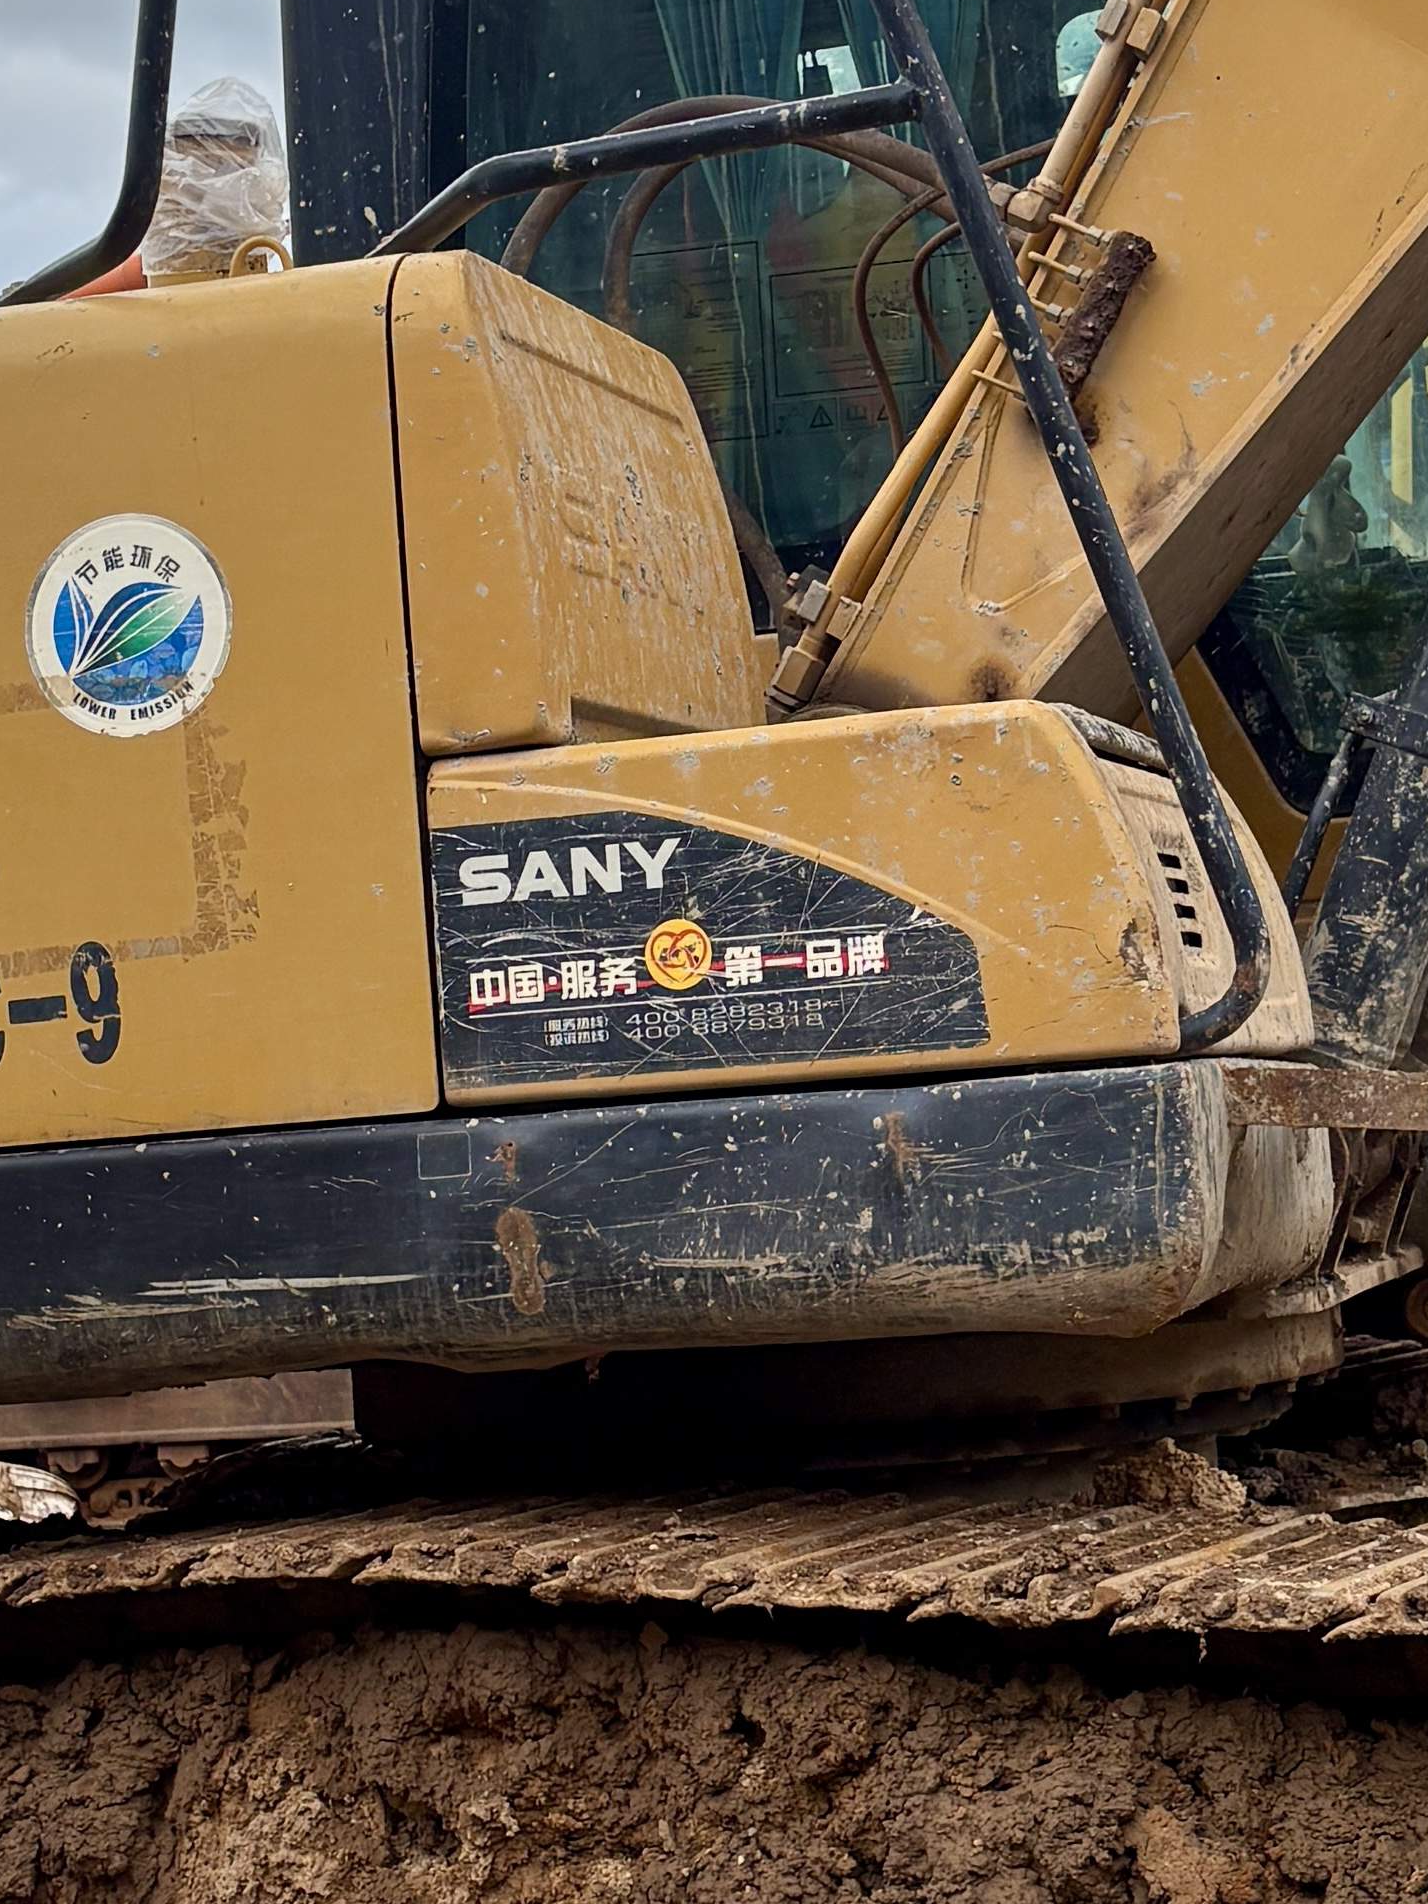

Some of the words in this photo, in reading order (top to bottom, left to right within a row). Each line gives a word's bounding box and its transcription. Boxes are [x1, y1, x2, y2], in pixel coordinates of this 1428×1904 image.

[74, 544, 181, 586] 节能环保
[73, 692, 117, 720] LOWER
[130, 680, 195, 721] EMISSION
[458, 837, 682, 907] SANY
[724, 933, 885, 987] 第一品牌
